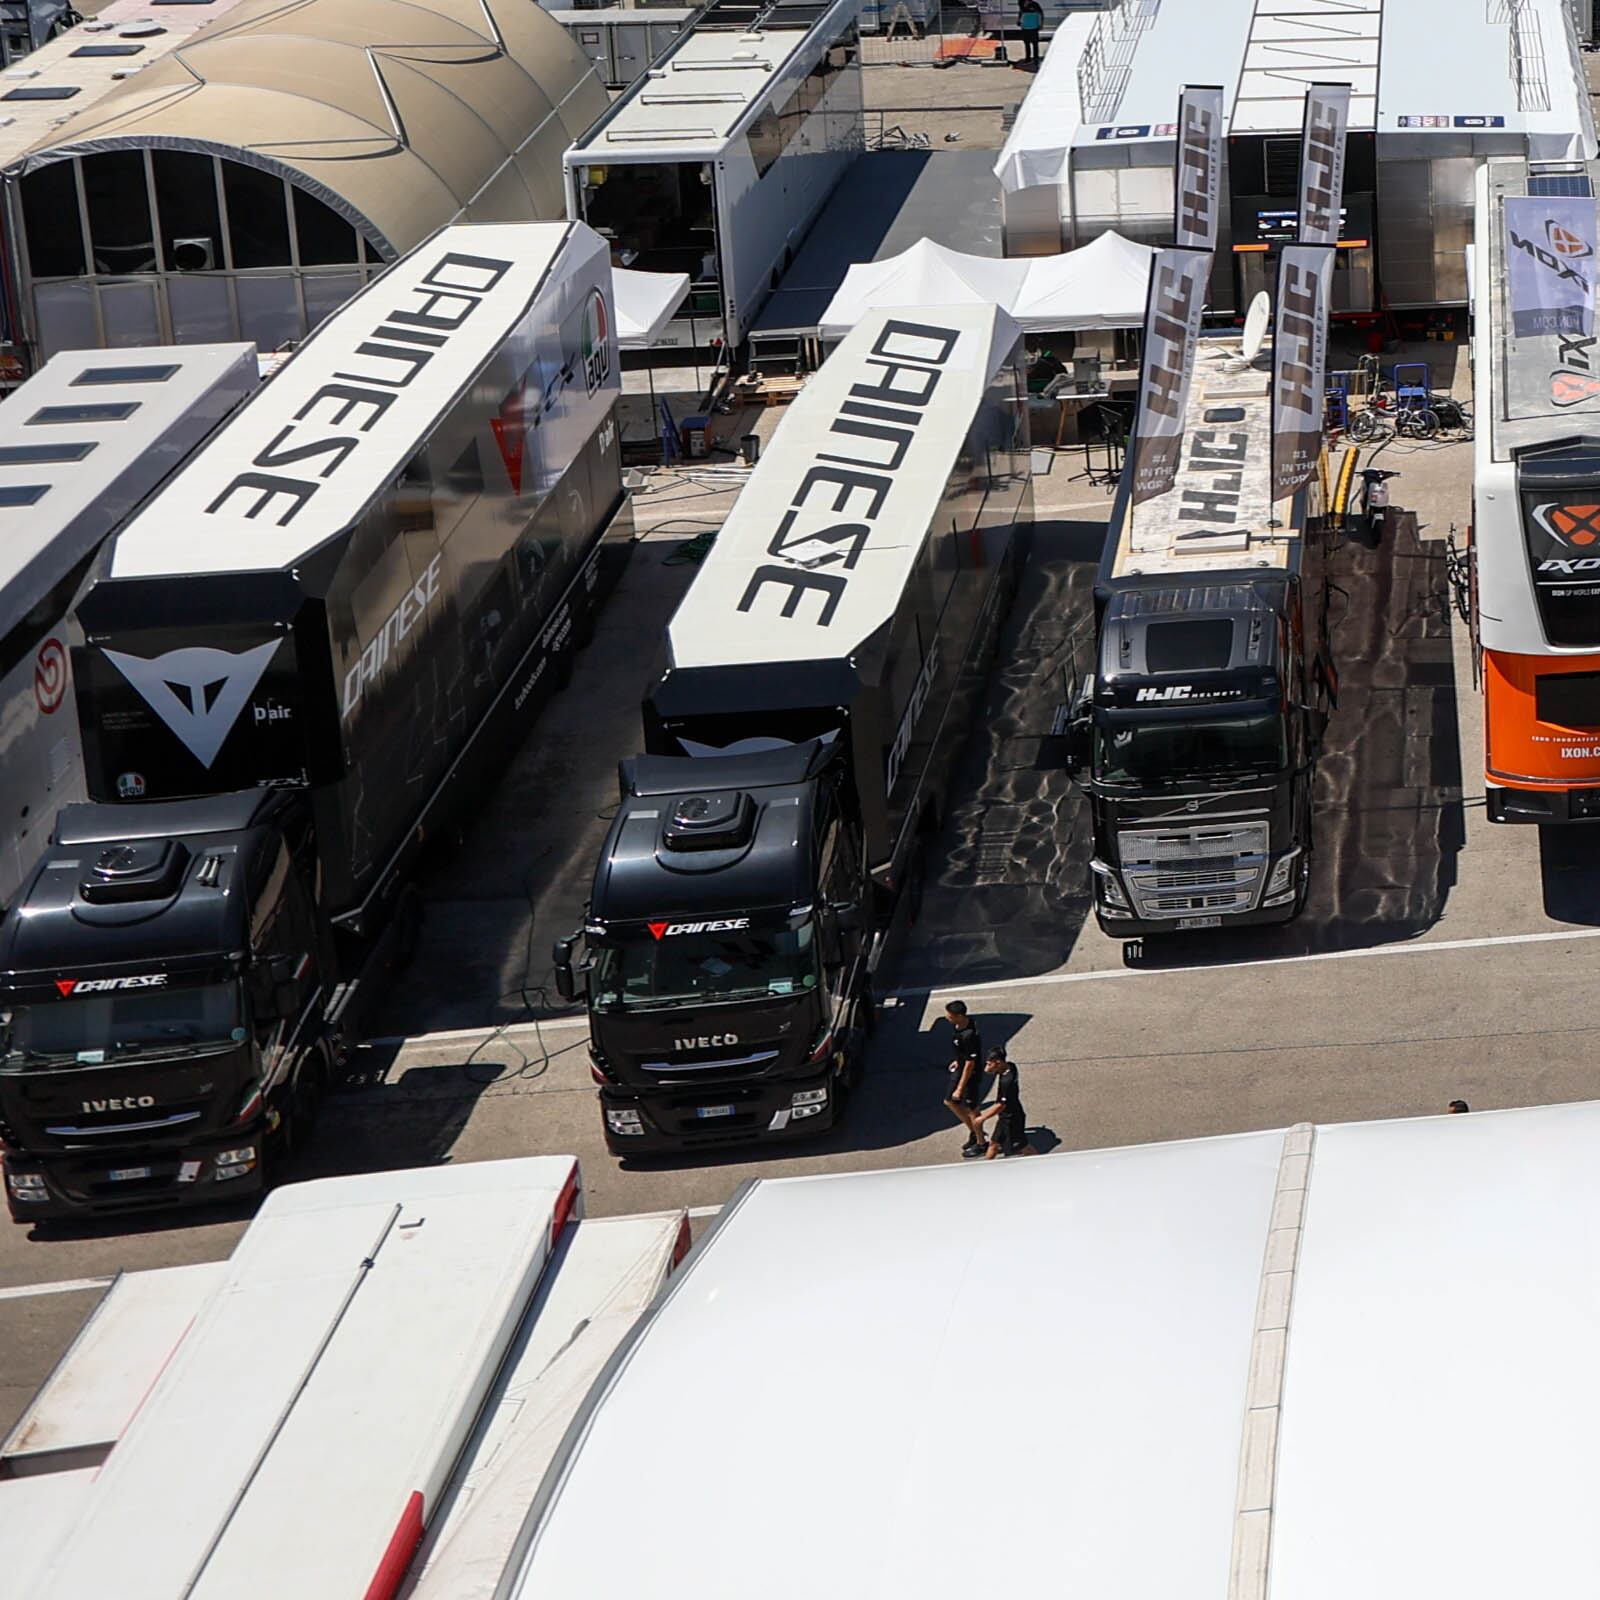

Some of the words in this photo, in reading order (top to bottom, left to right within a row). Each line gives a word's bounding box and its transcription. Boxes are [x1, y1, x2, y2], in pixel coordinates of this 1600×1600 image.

[1182, 103, 1213, 236] HJC
[1306, 98, 1339, 232] HJC
[203, 251, 515, 528] DAINESE
[1147, 265, 1195, 421] HJC
[1280, 263, 1319, 415] HJC
[737, 318, 962, 627] DAINESE
[342, 551, 441, 719] DAINESE
[1135, 686, 1193, 702] HJC
[1191, 690, 1242, 699] HELMETS
[73, 974, 168, 993] DAINESE
[664, 918, 750, 936] DAINESE
[82, 1095, 155, 1114] IVECO
[673, 1033, 739, 1050] IVECO
